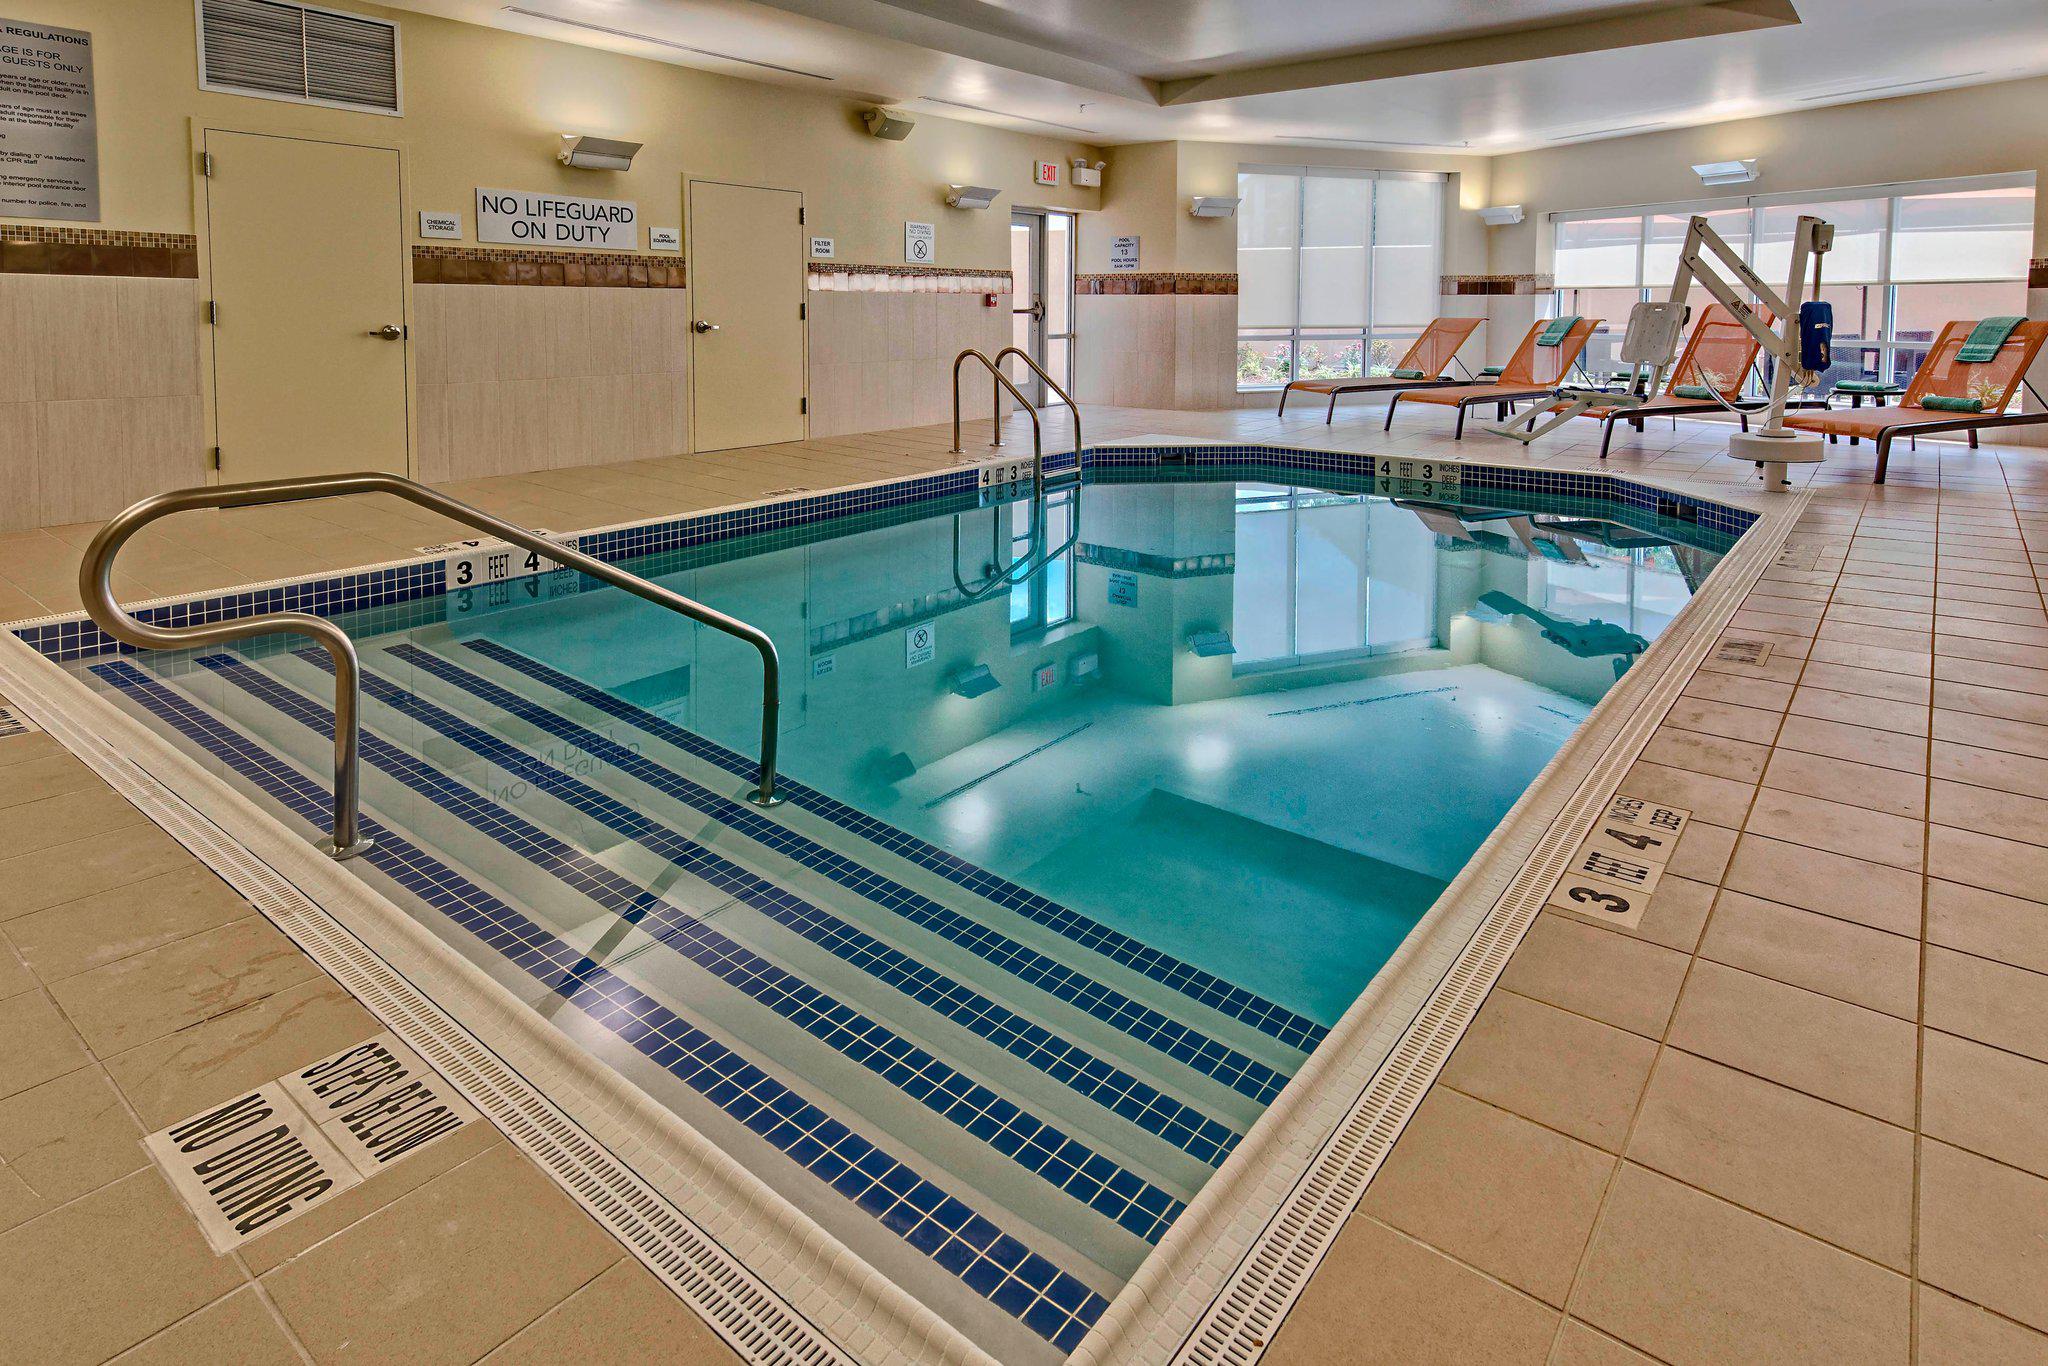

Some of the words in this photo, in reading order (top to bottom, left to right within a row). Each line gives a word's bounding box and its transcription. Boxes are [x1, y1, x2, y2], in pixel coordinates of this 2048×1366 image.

[6, 26, 88, 46] REGULATIONS
[22, 48, 33, 56] IS
[37, 50, 61, 60] FOR
[3, 56, 50, 69] GUESTS
[54, 63, 83, 74] ONLY
[29, 83, 52, 91] bathing
[29, 119, 52, 127] bathing
[9, 175, 46, 183] emergency
[1043, 164, 1056, 181] EXIT
[482, 195, 518, 215] NO
[525, 198, 634, 224] LIFEGUARD
[426, 218, 456, 227] CHEMICAL
[511, 220, 546, 239] ON
[556, 223, 610, 243] DUTY
[1120, 248, 1129, 256] 13
[983, 469, 990, 485] 4
[1010, 465, 1018, 480] 3
[1380, 460, 1392, 476] 4
[1399, 461, 1414, 478] FEET
[1422, 464, 1433, 480] 3
[1439, 463, 1460, 474] INCHES
[1441, 474, 1457, 484] DEEP
[456, 560, 474, 585] 3
[488, 553, 510, 580] FEET
[524, 550, 540, 572] 4
[1607, 796, 1645, 825] INCHES
[1649, 808, 1682, 831] DEEP
[1604, 827, 1663, 851] 4
[1582, 851, 1650, 885] FEET
[1568, 886, 1630, 913] 3
[300, 1042, 410, 1110] STEPS
[168, 1092, 274, 1153] NO
[339, 1080, 464, 1164] BELOW
[192, 1123, 334, 1236] DIVING
